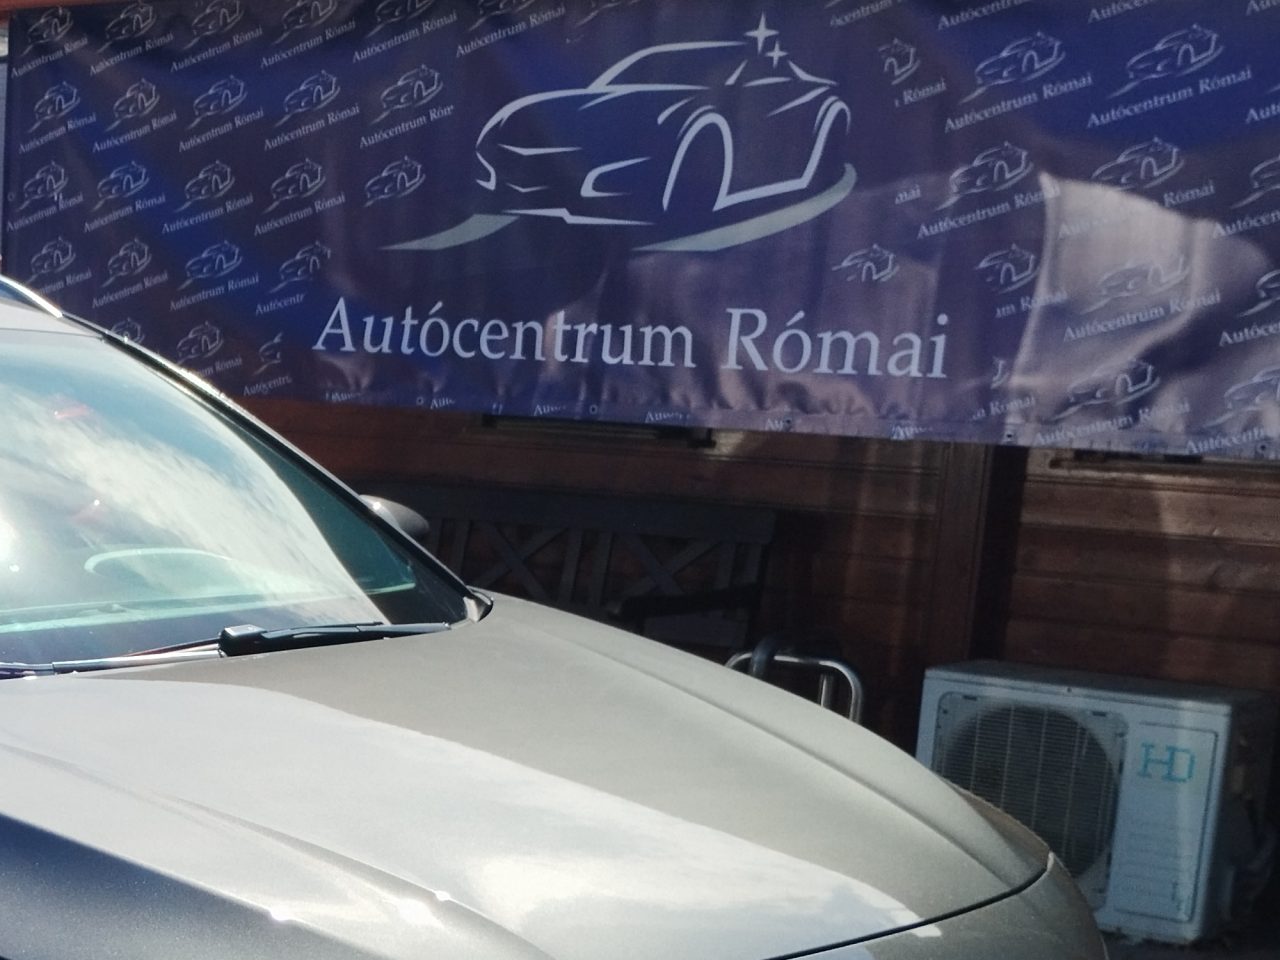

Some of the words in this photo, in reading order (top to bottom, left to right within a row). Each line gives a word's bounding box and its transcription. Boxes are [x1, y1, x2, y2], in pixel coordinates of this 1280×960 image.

[352, 28, 420, 63] Autócentrum
[421, 10, 458, 35] Római
[455, 23, 526, 58] Autócentrum
[945, 91, 1038, 133] Autócentrum
[1042, 72, 1093, 100] Római
[1086, 85, 1194, 129] Autócentrum
[1198, 64, 1253, 95] Római
[263, 119, 326, 151] Autócentrum
[359, 115, 427, 149] Autócentrum
[1163, 178, 1216, 207] Római
[917, 201, 1011, 240] Autócentrum
[313, 296, 697, 369] Autócentrum
[721, 307, 948, 379] Római
[1138, 742, 1196, 784] HD
